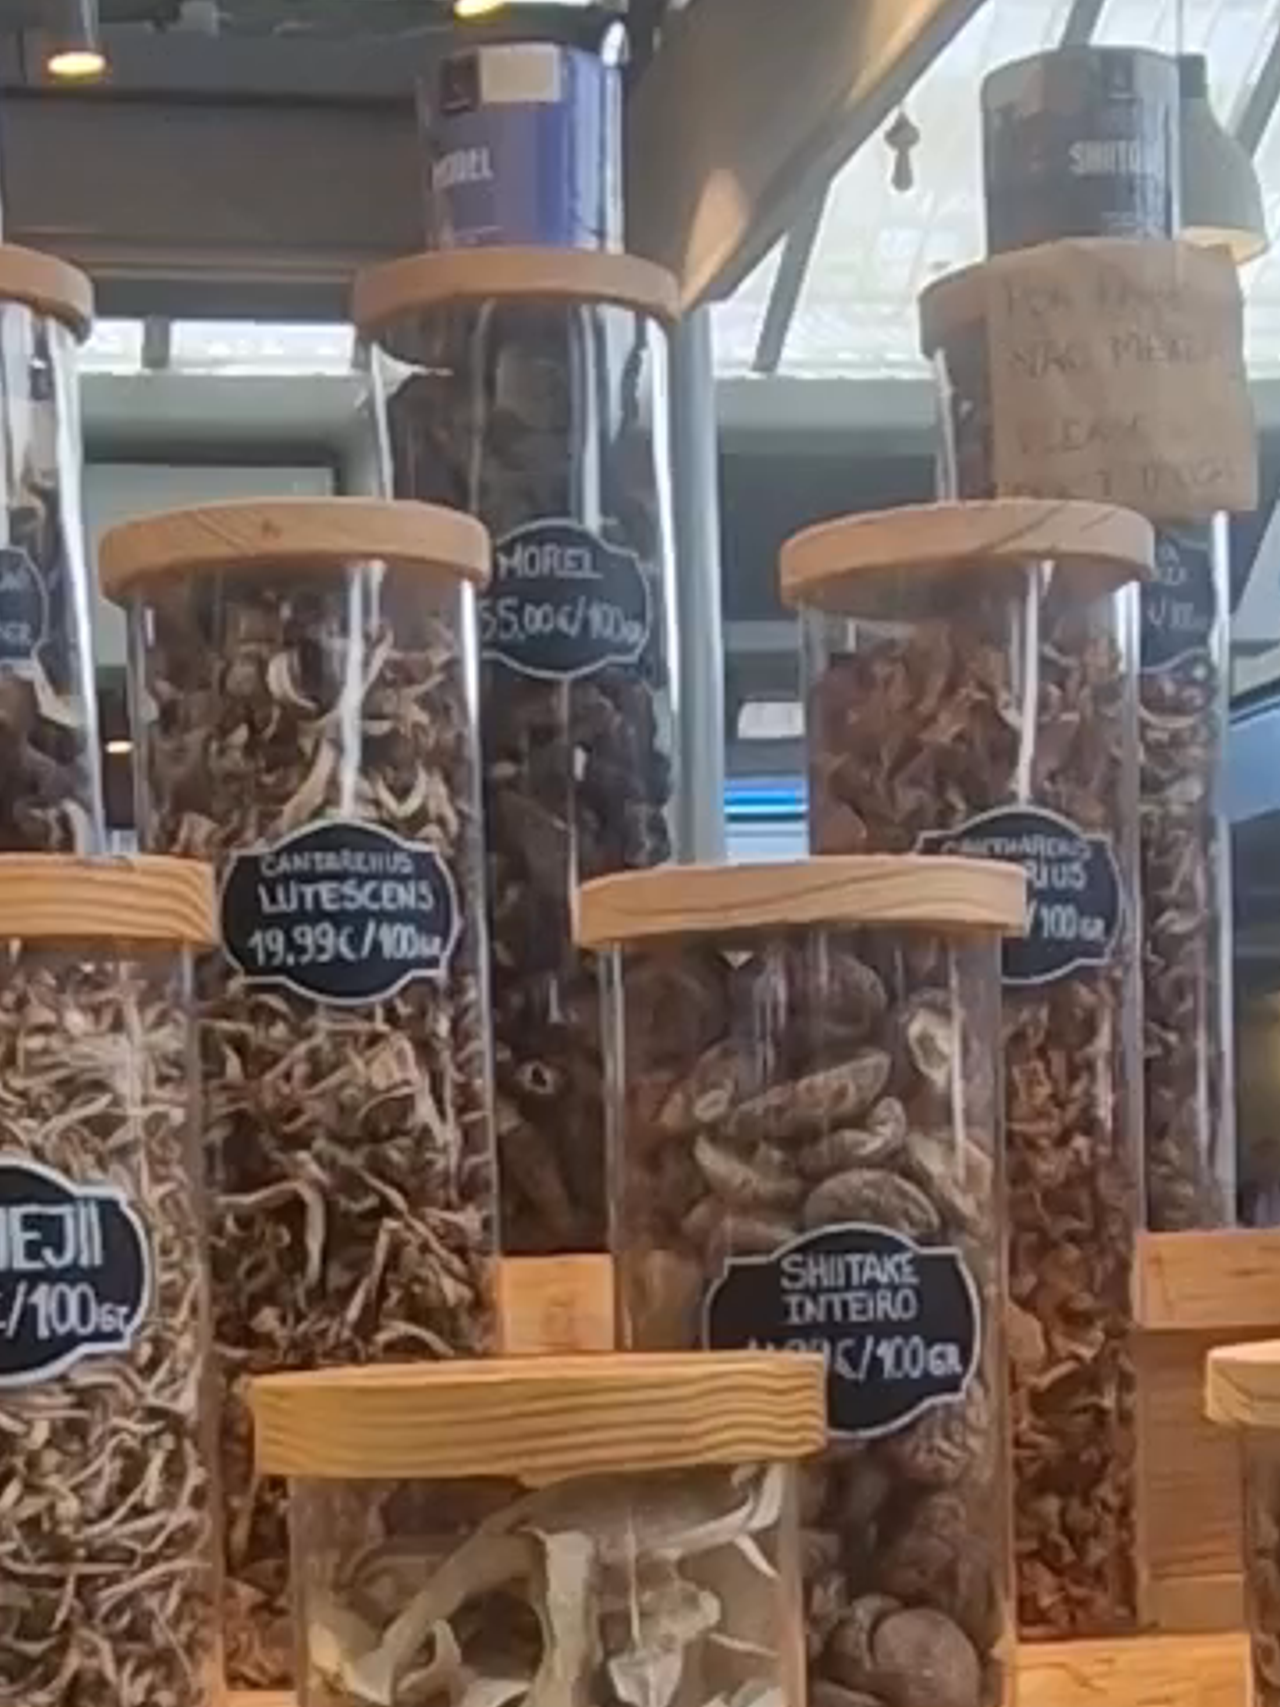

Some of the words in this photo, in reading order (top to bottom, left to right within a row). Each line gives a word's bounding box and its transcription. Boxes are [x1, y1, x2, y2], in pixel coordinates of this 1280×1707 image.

[495, 542, 605, 581] MOREL
[257, 879, 435, 914] LUTESCENS
[780, 1250, 920, 1291] SHIITAKE
[781, 1289, 920, 1326] INTEIRO
